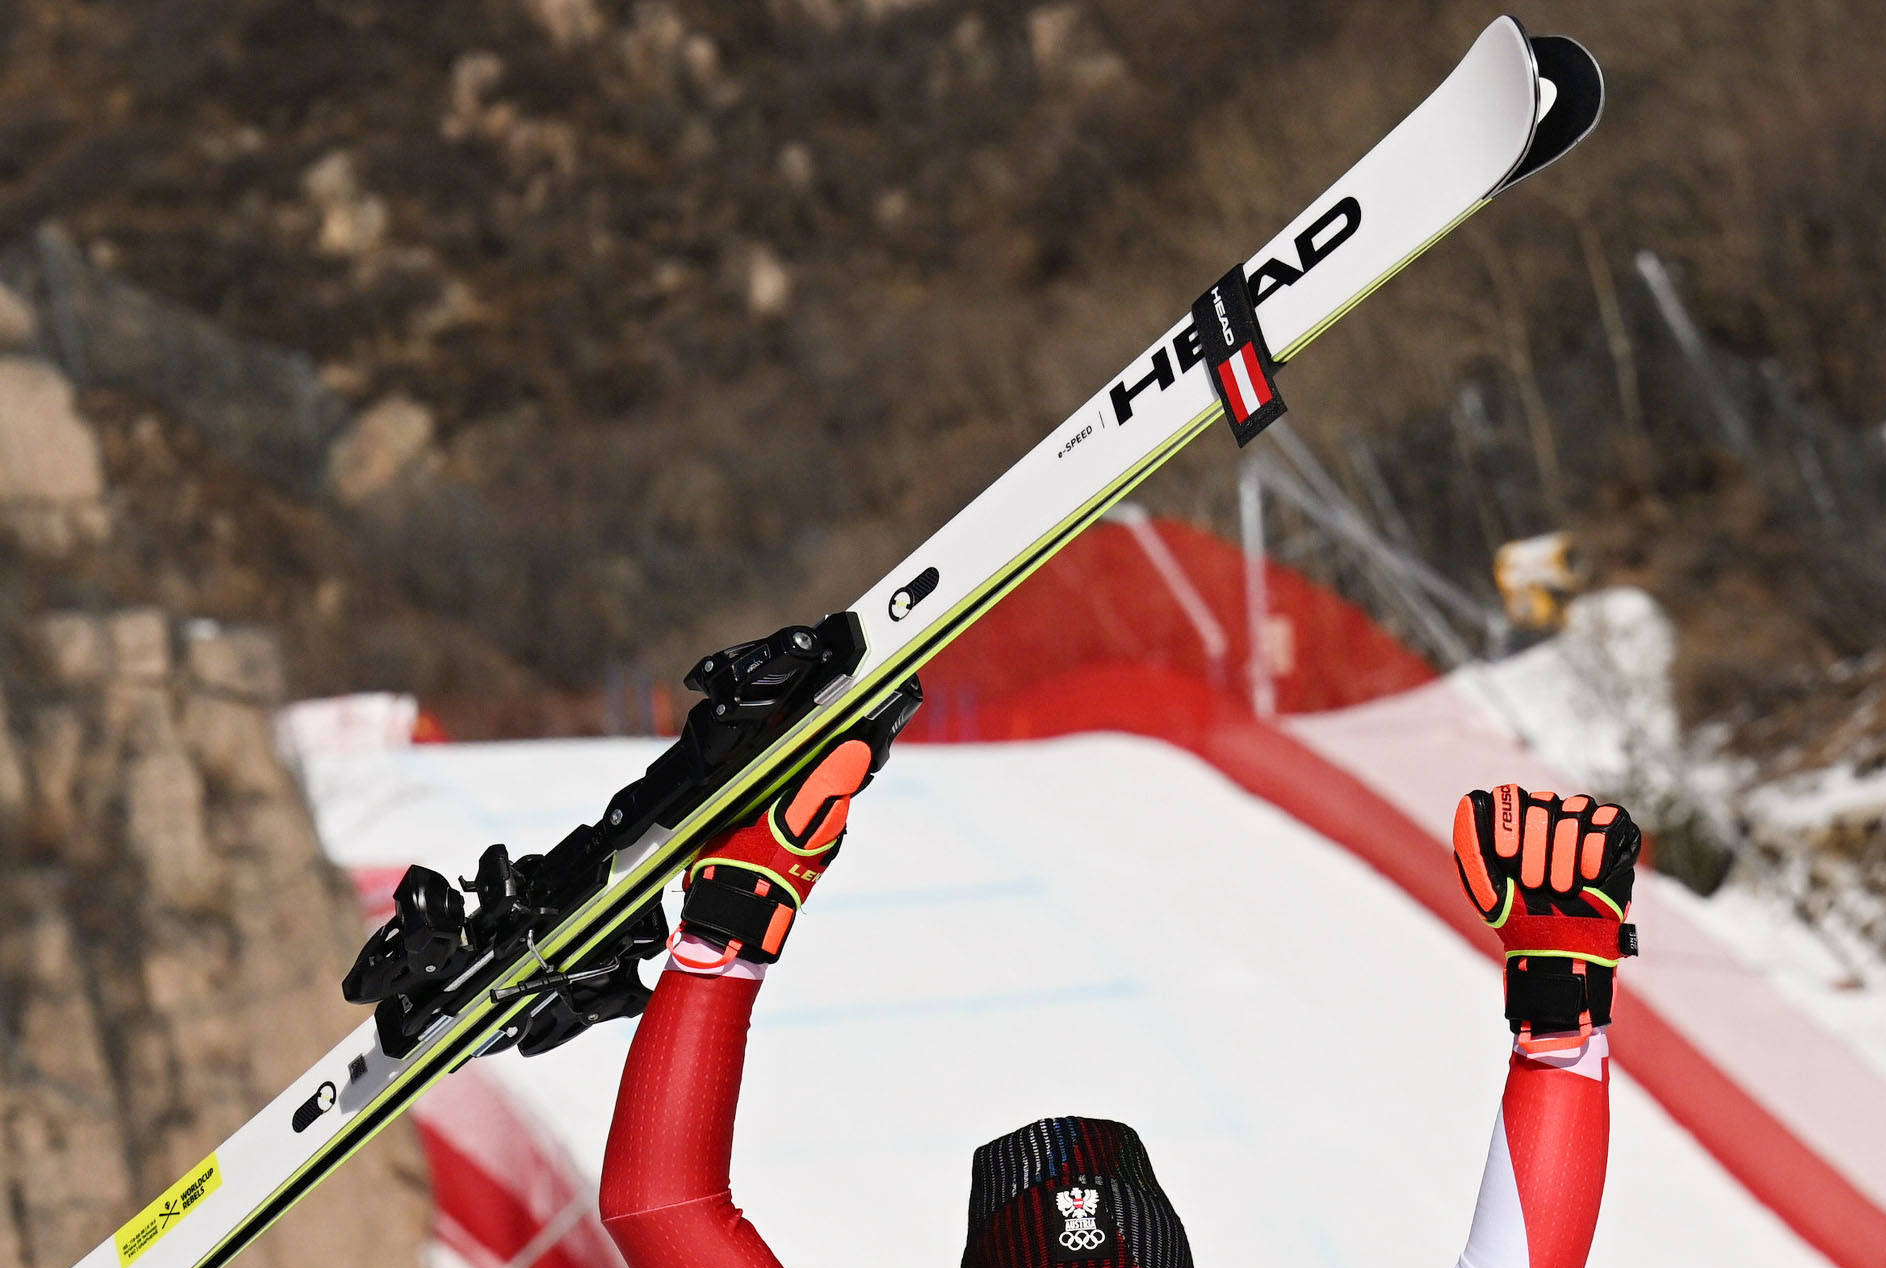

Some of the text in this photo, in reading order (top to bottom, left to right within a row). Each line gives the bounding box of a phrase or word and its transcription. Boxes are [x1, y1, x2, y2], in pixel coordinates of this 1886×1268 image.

[1211, 286, 1235, 347] HEAD
[1500, 784, 1513, 832] reusc
[180, 1167, 214, 1202] WORLDCUP
[182, 1185, 205, 1210] REBELS
[1065, 1218, 1097, 1231] AUSTRIA
